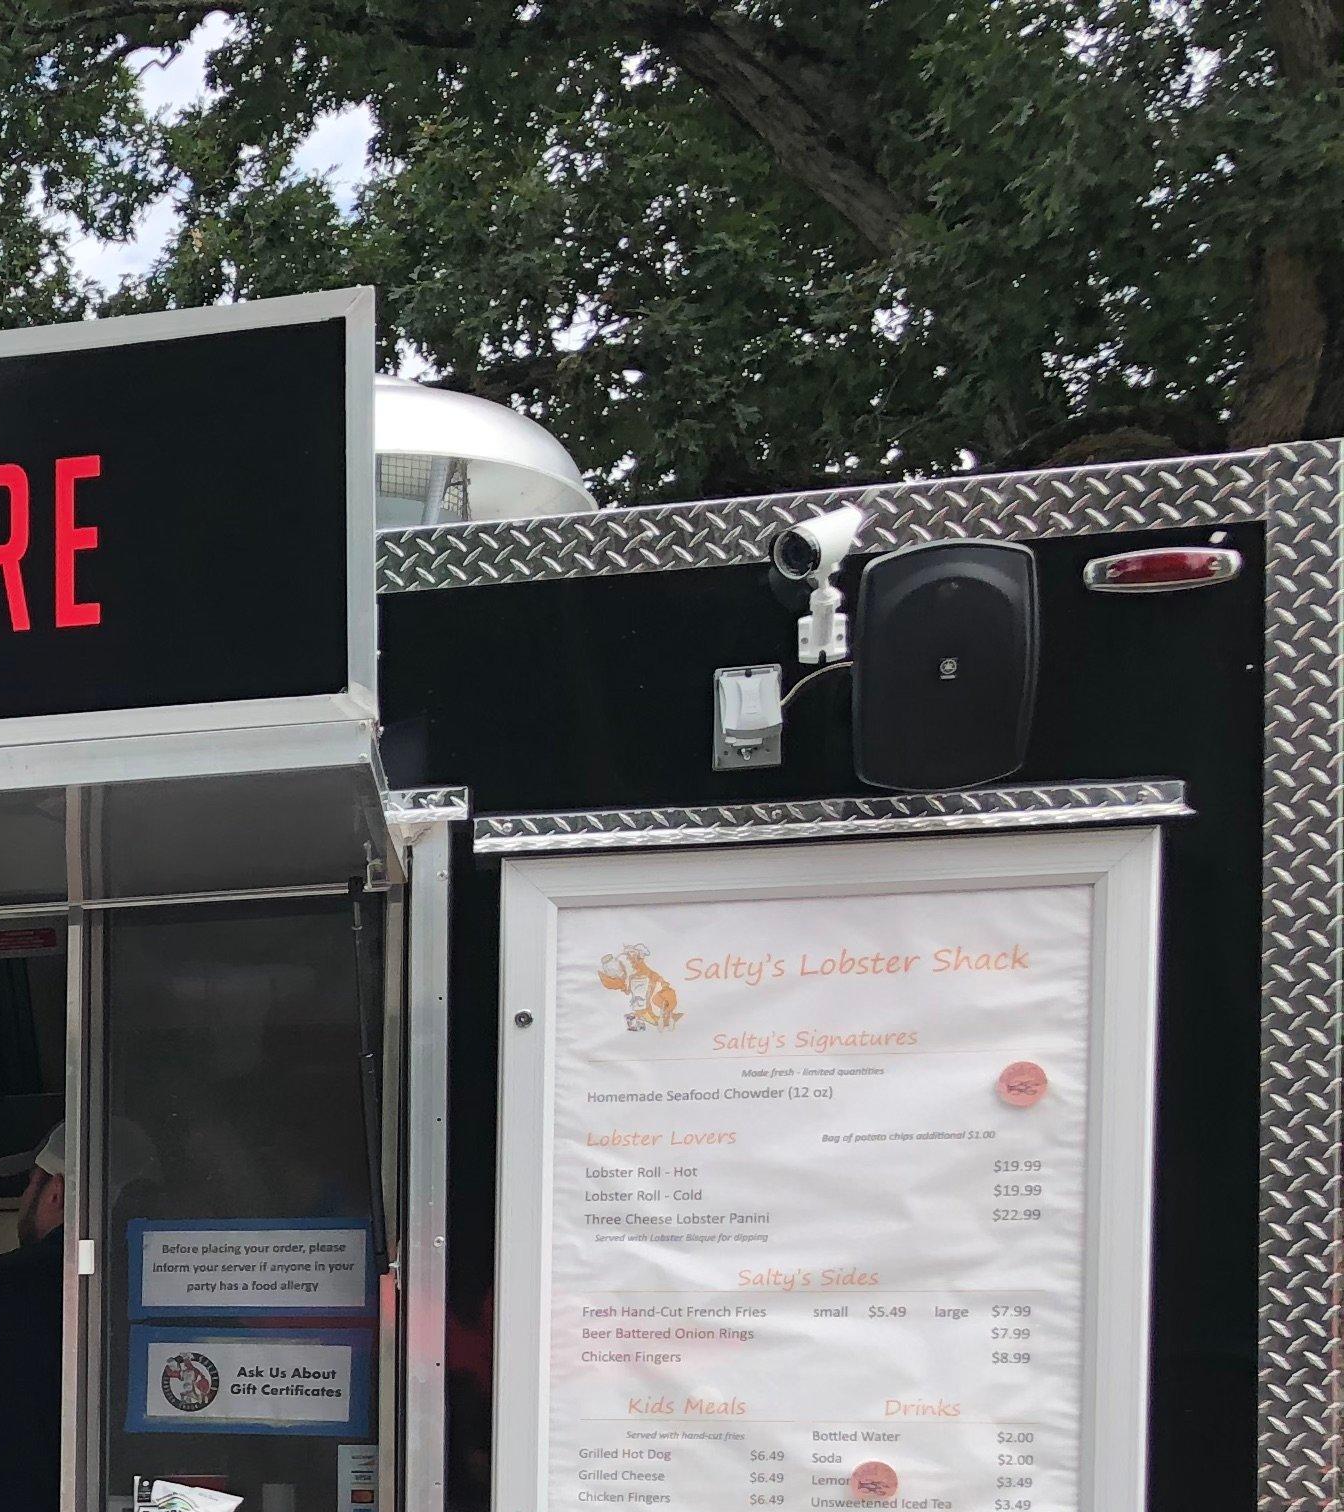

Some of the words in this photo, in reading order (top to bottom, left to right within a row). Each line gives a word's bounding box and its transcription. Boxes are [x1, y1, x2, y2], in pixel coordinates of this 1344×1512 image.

[684, 954, 786, 986] Salty's
[800, 944, 921, 976] Lobster
[932, 943, 1030, 973] Shack
[713, 1032, 786, 1055] Salty's
[794, 1029, 919, 1053] Signatures
[587, 1091, 663, 1103] Homemade
[666, 1088, 719, 1101] Seafood
[724, 1087, 784, 1100] Chowder
[788, 1086, 809, 1100] (12
[813, 1086, 833, 1099] oz)
[586, 1129, 663, 1147] Lobster
[670, 1130, 737, 1146] Lovers
[585, 1166, 634, 1178] Lobster
[637, 1166, 661, 1178] Roll
[673, 1166, 698, 1177] Hot
[993, 1160, 1042, 1172] $19.99
[585, 1190, 633, 1202] Lobster
[637, 1190, 661, 1201] Roll
[672, 1189, 703, 1201] Cold
[993, 1184, 1042, 1197] $19.99
[584, 1214, 622, 1225] Three
[625, 1213, 672, 1225] Cheese
[676, 1213, 725, 1225] Lobster
[729, 1212, 770, 1224] Panini
[992, 1208, 1042, 1222] $22.99
[162, 1243, 199, 1255] Before
[201, 1243, 241, 1256] placing
[243, 1245, 269, 1256] your
[272, 1242, 306, 1255] order,
[308, 1242, 347, 1255] please
[152, 1261, 190, 1273] inform
[192, 1263, 219, 1275] your
[221, 1263, 256, 1273] server
[259, 1261, 268, 1273] if
[270, 1263, 312, 1275] anyone
[314, 1261, 326, 1271] in
[328, 1262, 355, 1274] your
[738, 1268, 811, 1291] Salty's
[821, 1267, 880, 1286] Sides
[186, 1282, 217, 1293] party
[219, 1281, 239, 1291] has
[251, 1280, 277, 1291] food
[280, 1280, 319, 1293] allergy
[582, 1306, 617, 1318] Fresh
[621, 1306, 683, 1318] Hand-Cut
[687, 1306, 731, 1318] French
[735, 1306, 767, 1317] Fries
[813, 1306, 848, 1317] small
[868, 1305, 907, 1318] $5.49
[935, 1306, 969, 1320] large
[992, 1304, 1031, 1318] $7.99
[582, 1328, 612, 1339] Beer
[615, 1328, 671, 1339] Battered
[674, 1328, 715, 1339] Onion
[719, 1328, 754, 1341] Rings
[991, 1327, 1031, 1339] $7.99
[237, 1366, 265, 1378] Ask
[269, 1367, 287, 1379] Us
[291, 1366, 337, 1380] About
[230, 1383, 257, 1396] Gift
[260, 1384, 343, 1398] Certificates
[885, 1399, 961, 1417] Drinks
[812, 1430, 857, 1441] Bottled
[861, 1431, 901, 1441] Water
[997, 1431, 1034, 1443] $2.00
[811, 1497, 898, 1510] Unsweetened
[901, 1498, 928, 1509] Iced
[931, 1499, 952, 1509] Tea
